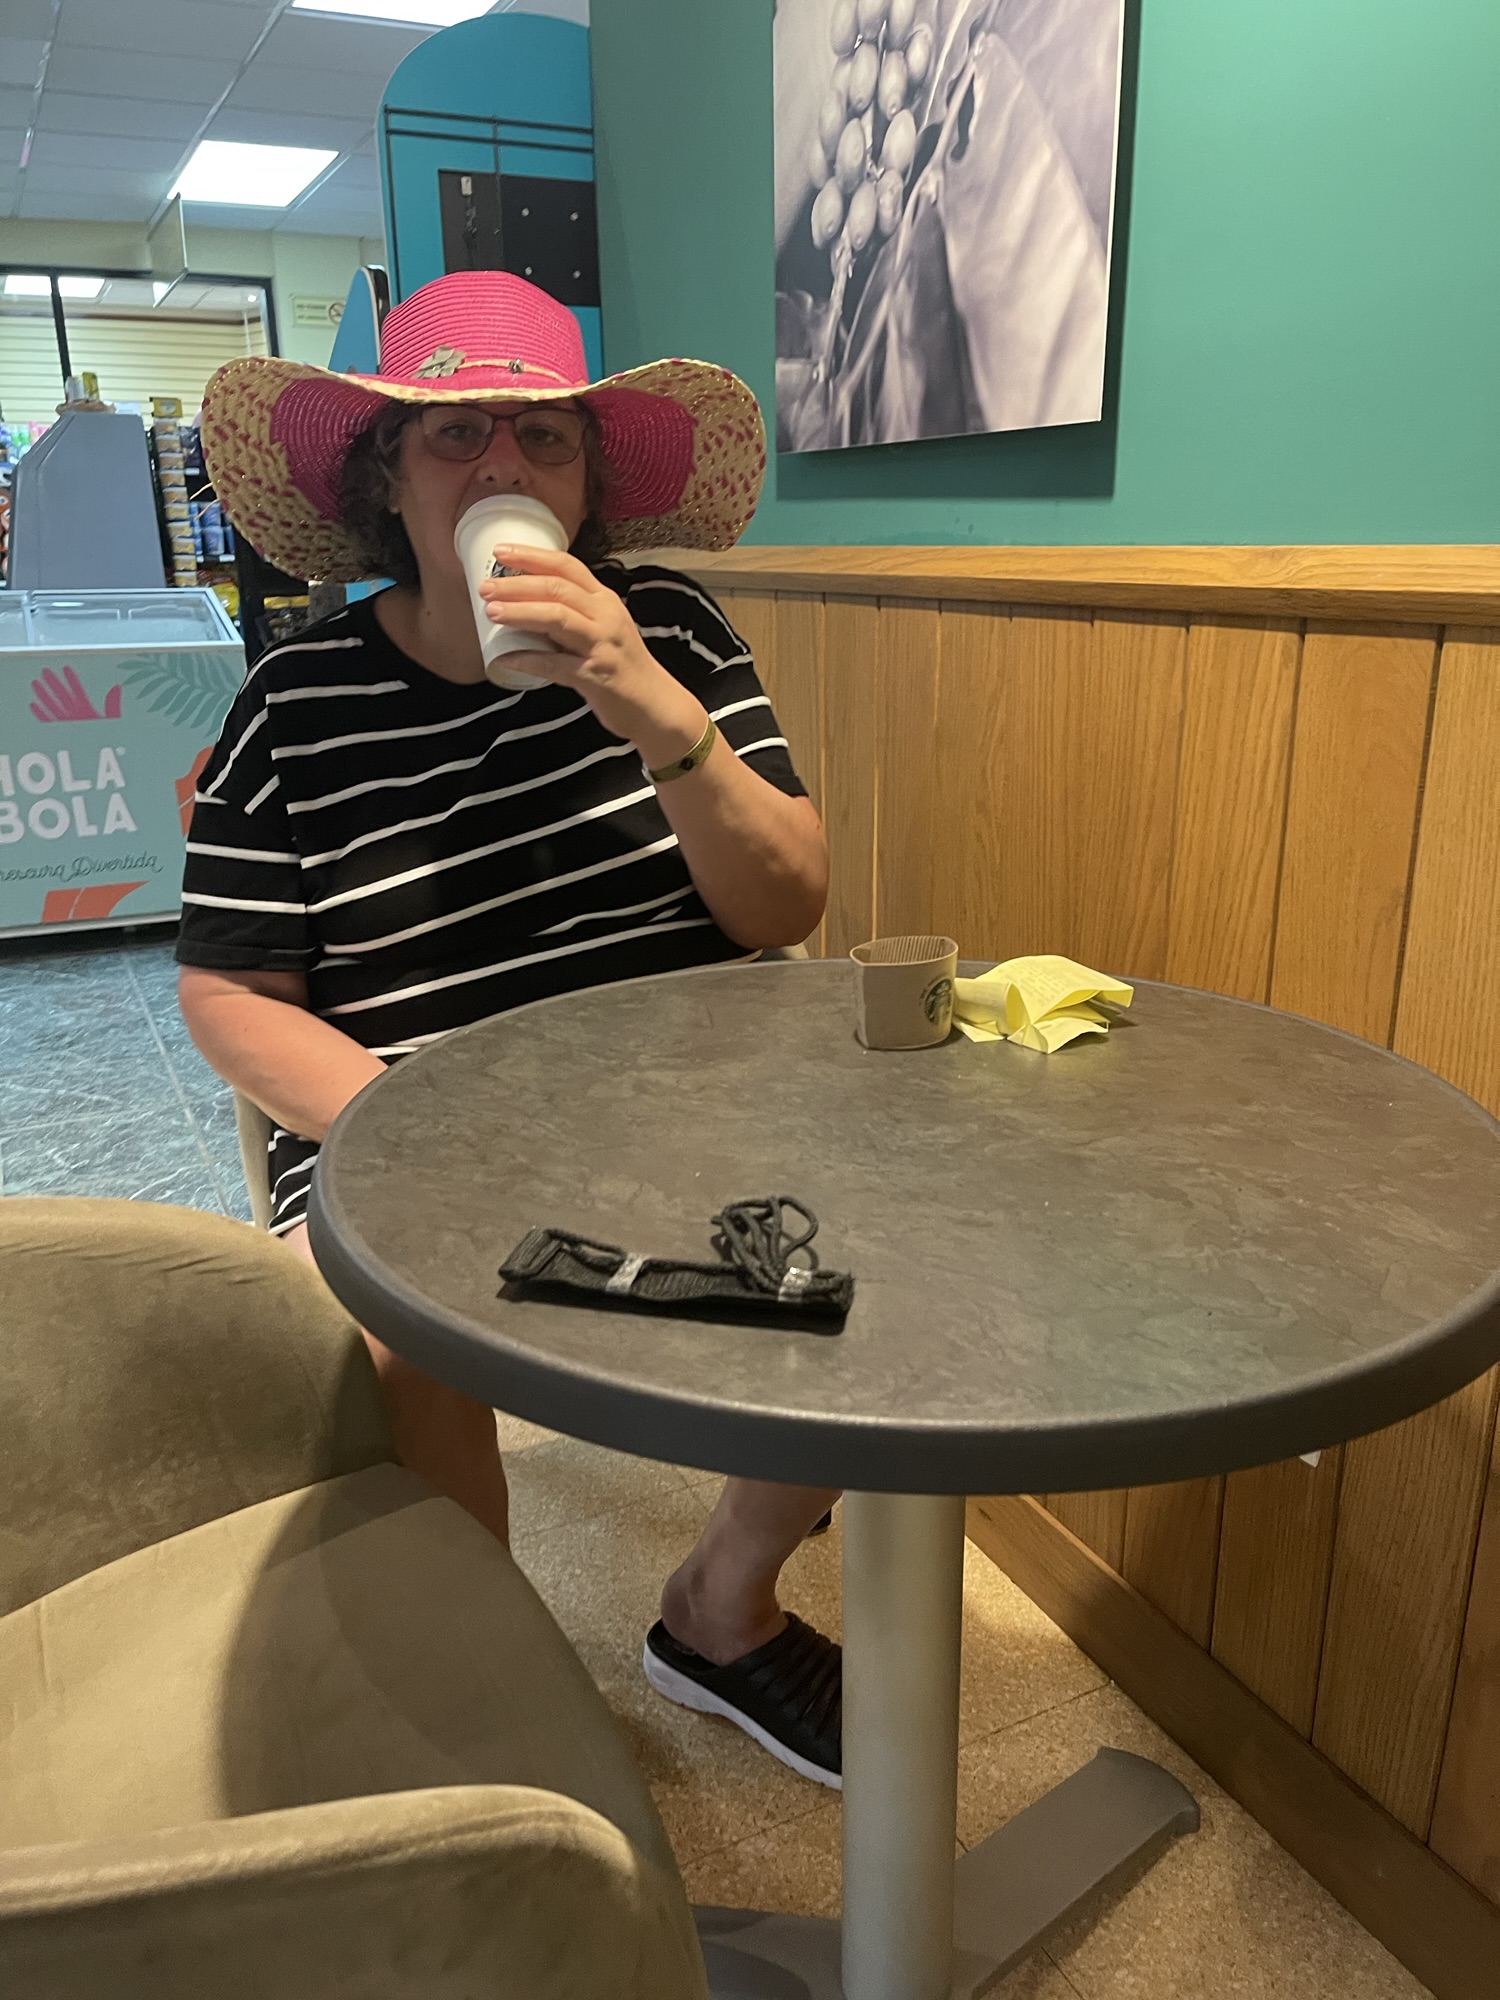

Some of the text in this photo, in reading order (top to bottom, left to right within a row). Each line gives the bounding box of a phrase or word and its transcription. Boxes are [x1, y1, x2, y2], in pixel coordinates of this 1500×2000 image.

[0, 792, 138, 844] BOLA
[0, 851, 163, 882] rescura Divertida
